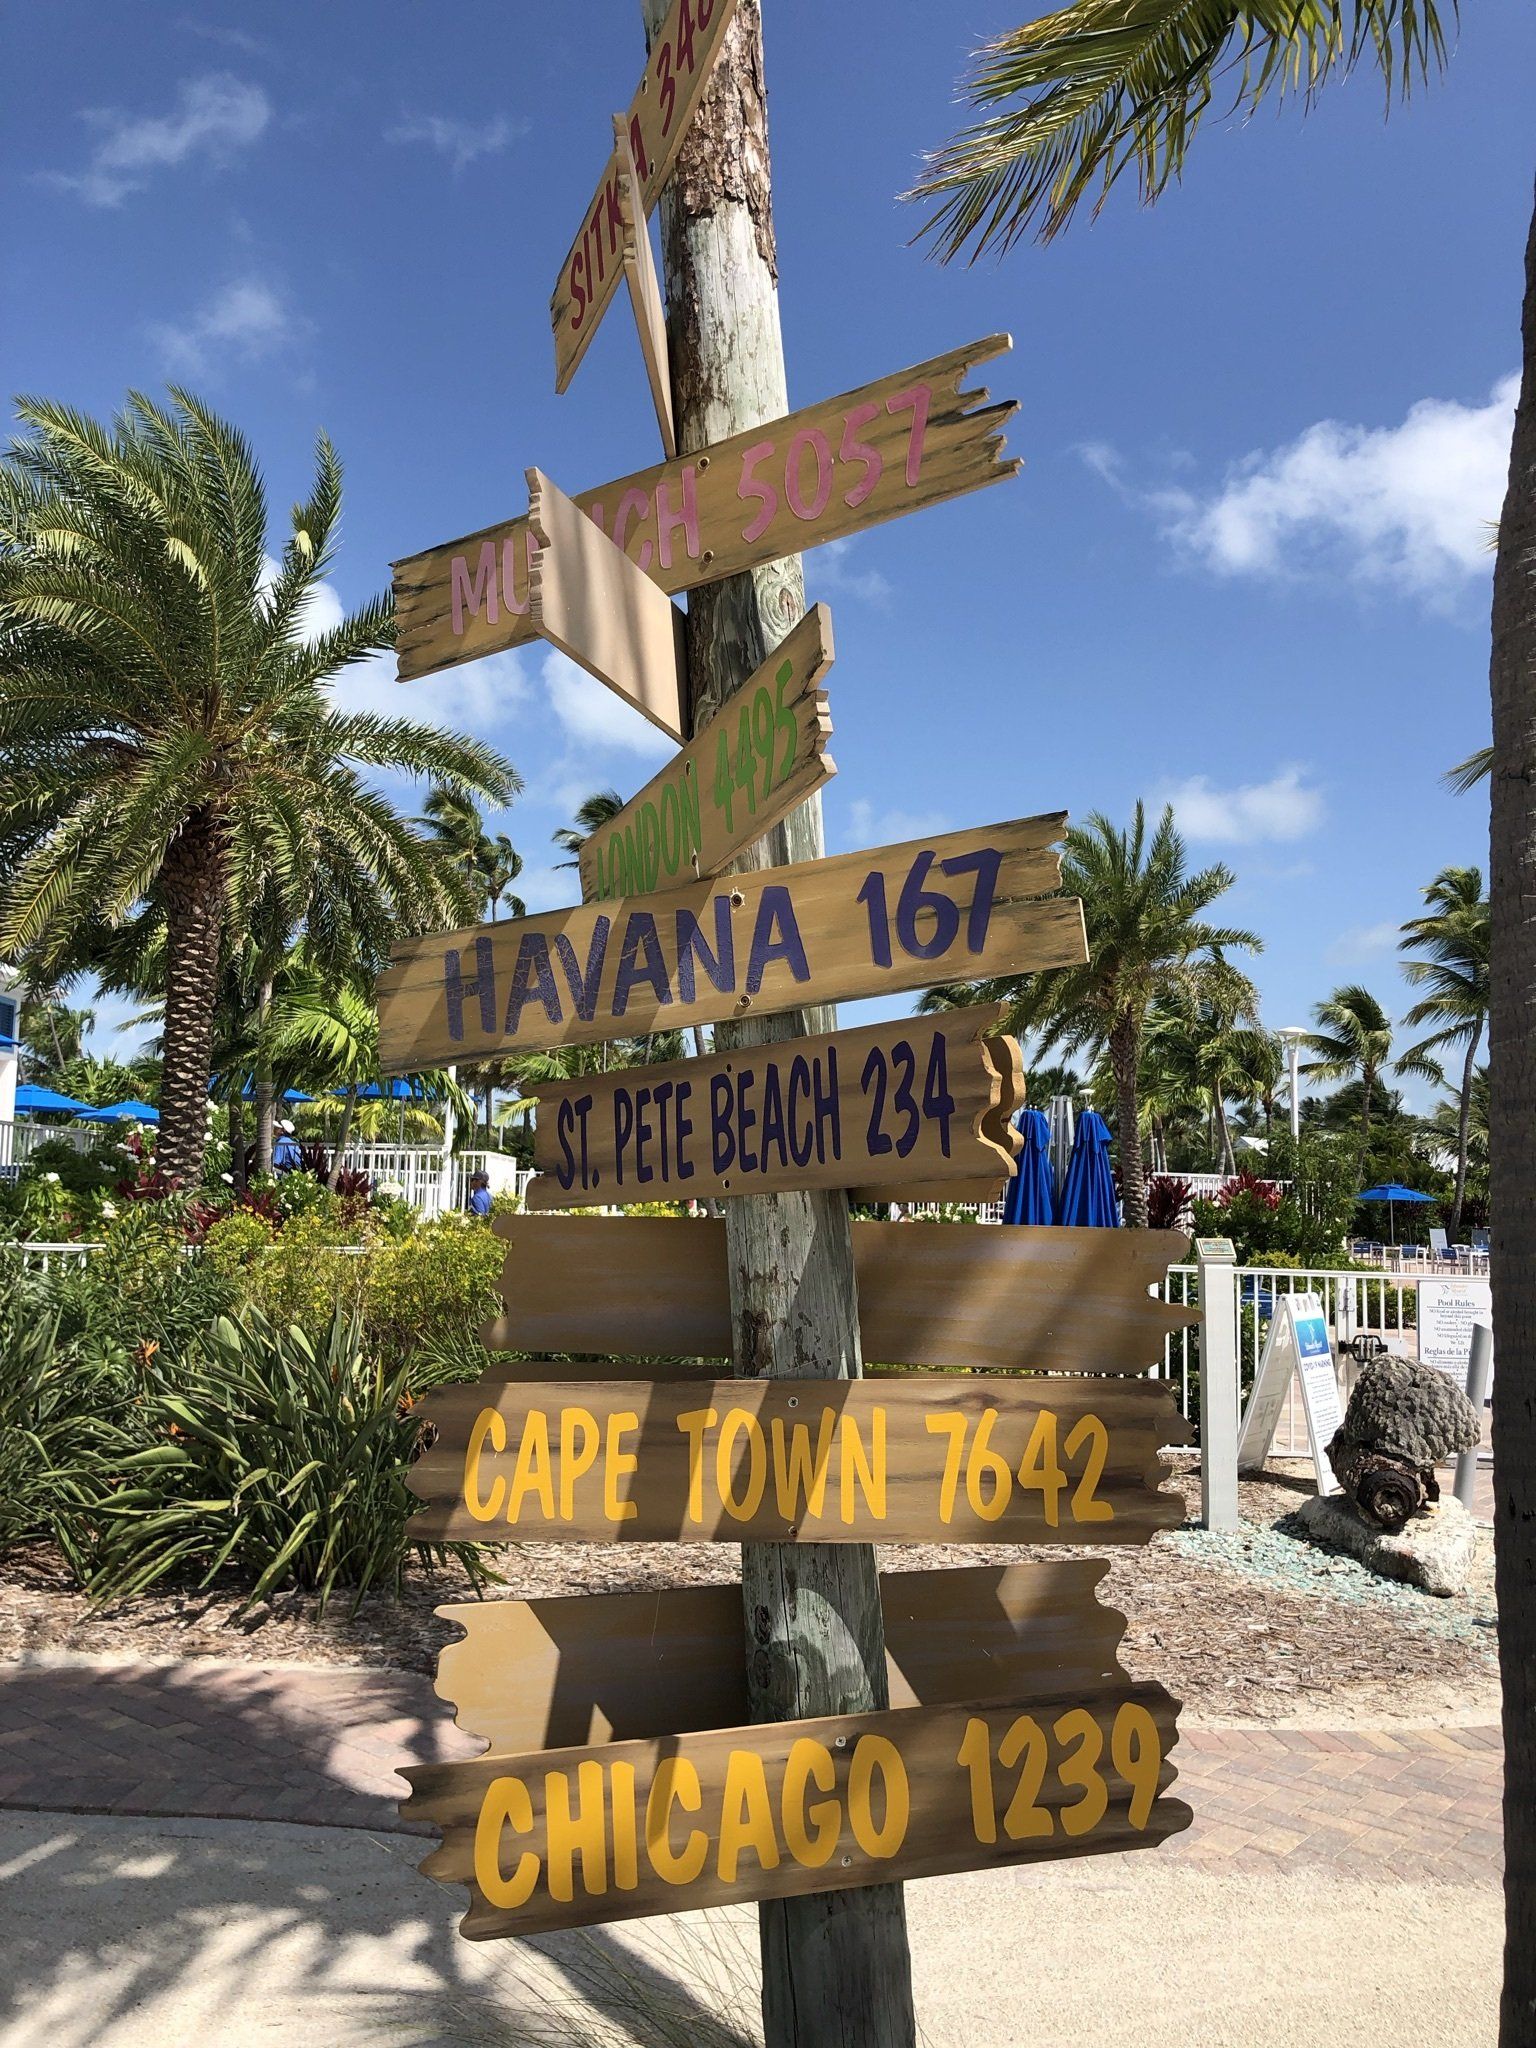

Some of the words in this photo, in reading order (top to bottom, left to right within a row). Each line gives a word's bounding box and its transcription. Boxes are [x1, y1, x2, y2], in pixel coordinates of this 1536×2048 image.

[451, 466, 699, 635] MUCH
[737, 384, 933, 543] 5057
[598, 757, 702, 899] LONDON
[715, 659, 798, 834] 4495
[444, 886, 811, 1041] HAVANA
[856, 848, 1002, 970] 167
[555, 1094, 600, 1191] ST.
[614, 1081, 694, 1184] PETE
[712, 1045, 842, 1177] BEACH
[861, 1030, 955, 1160] 234
[1424, 1347, 1446, 1357] Reglas
[1446, 1348, 1456, 1356] de
[1456, 1348, 1463, 1356] la
[1437, 1299, 1453, 1307] Pool
[464, 1408, 639, 1523] CAPE
[677, 1407, 887, 1525] TOWN
[925, 1408, 1114, 1528] 7642
[474, 1734, 909, 1909] CHICAGO
[956, 1702, 1162, 1844] 1239
